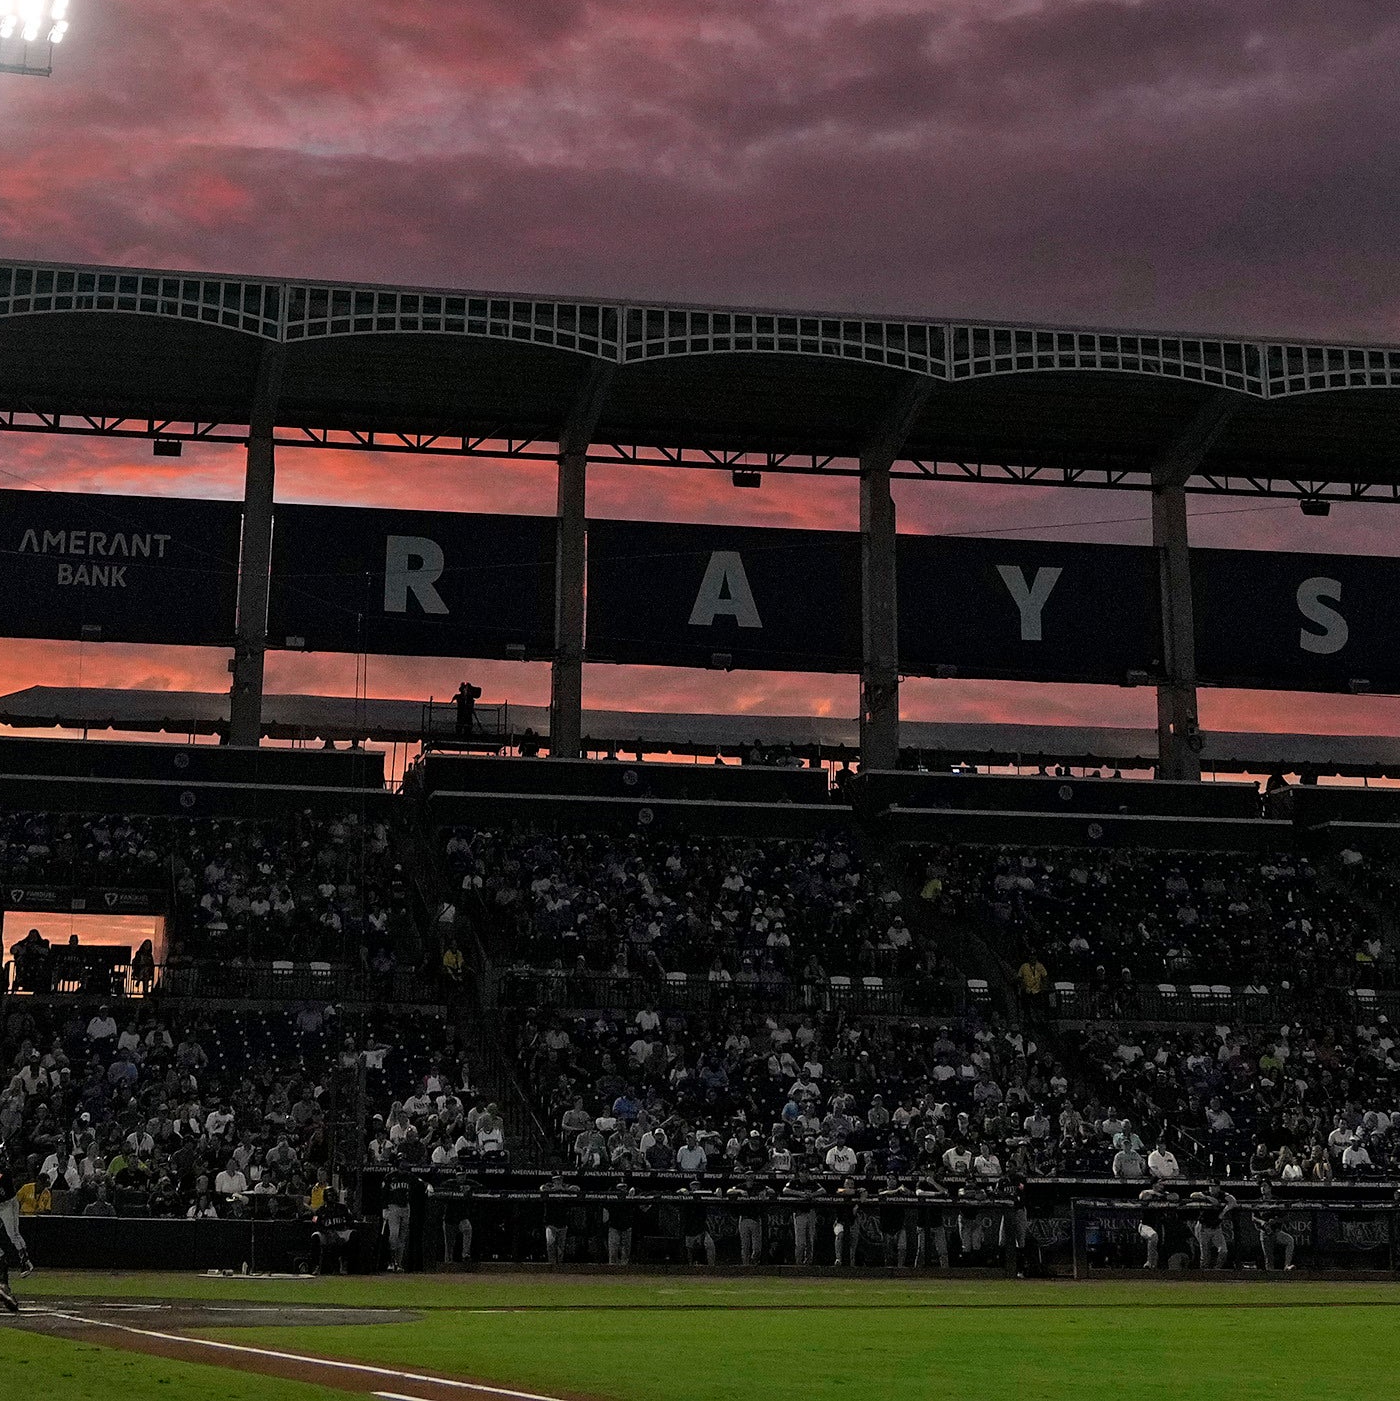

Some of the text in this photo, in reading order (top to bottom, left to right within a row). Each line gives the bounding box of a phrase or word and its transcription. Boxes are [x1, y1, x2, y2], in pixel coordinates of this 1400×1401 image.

[18, 529, 172, 558] AMERANT
[57, 563, 127, 588] BANK
[382, 534, 1349, 655] R A Y S
